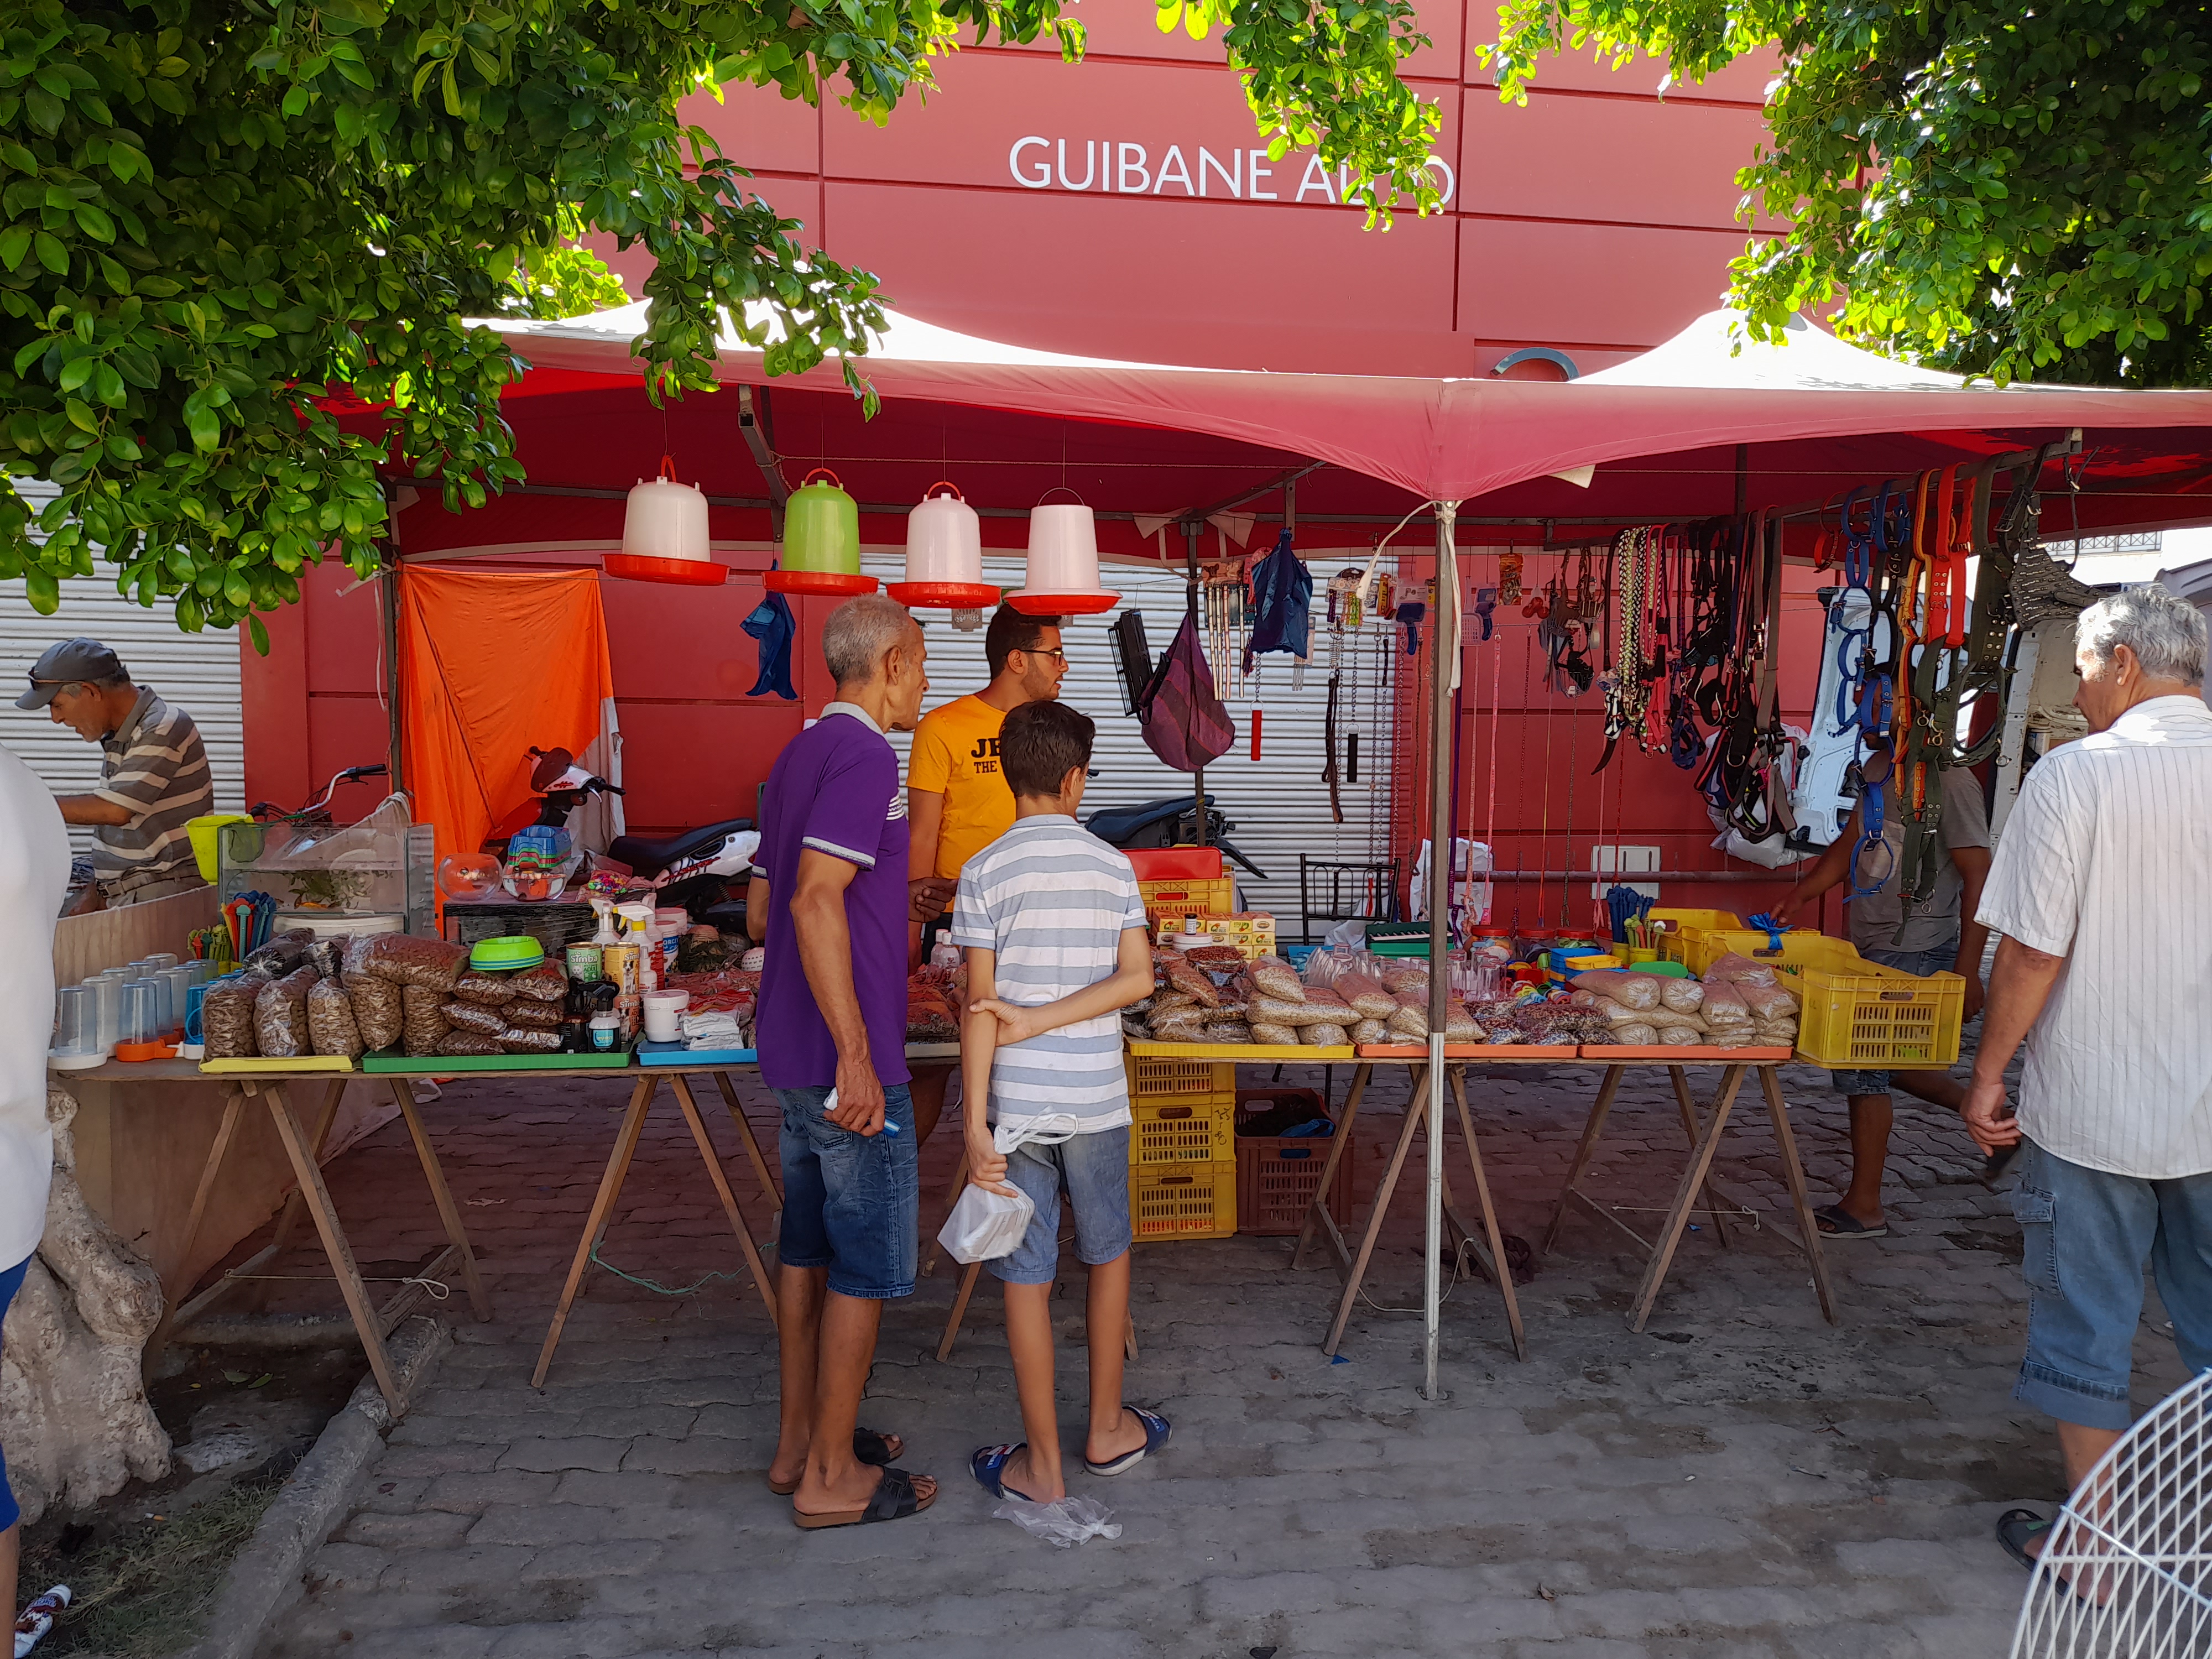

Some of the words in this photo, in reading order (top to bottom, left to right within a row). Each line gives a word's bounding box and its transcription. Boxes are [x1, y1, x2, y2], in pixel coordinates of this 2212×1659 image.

[1009, 135, 1279, 200] GUIBANE
[973, 760, 998, 774] THE
[570, 952, 598, 963] Simba
